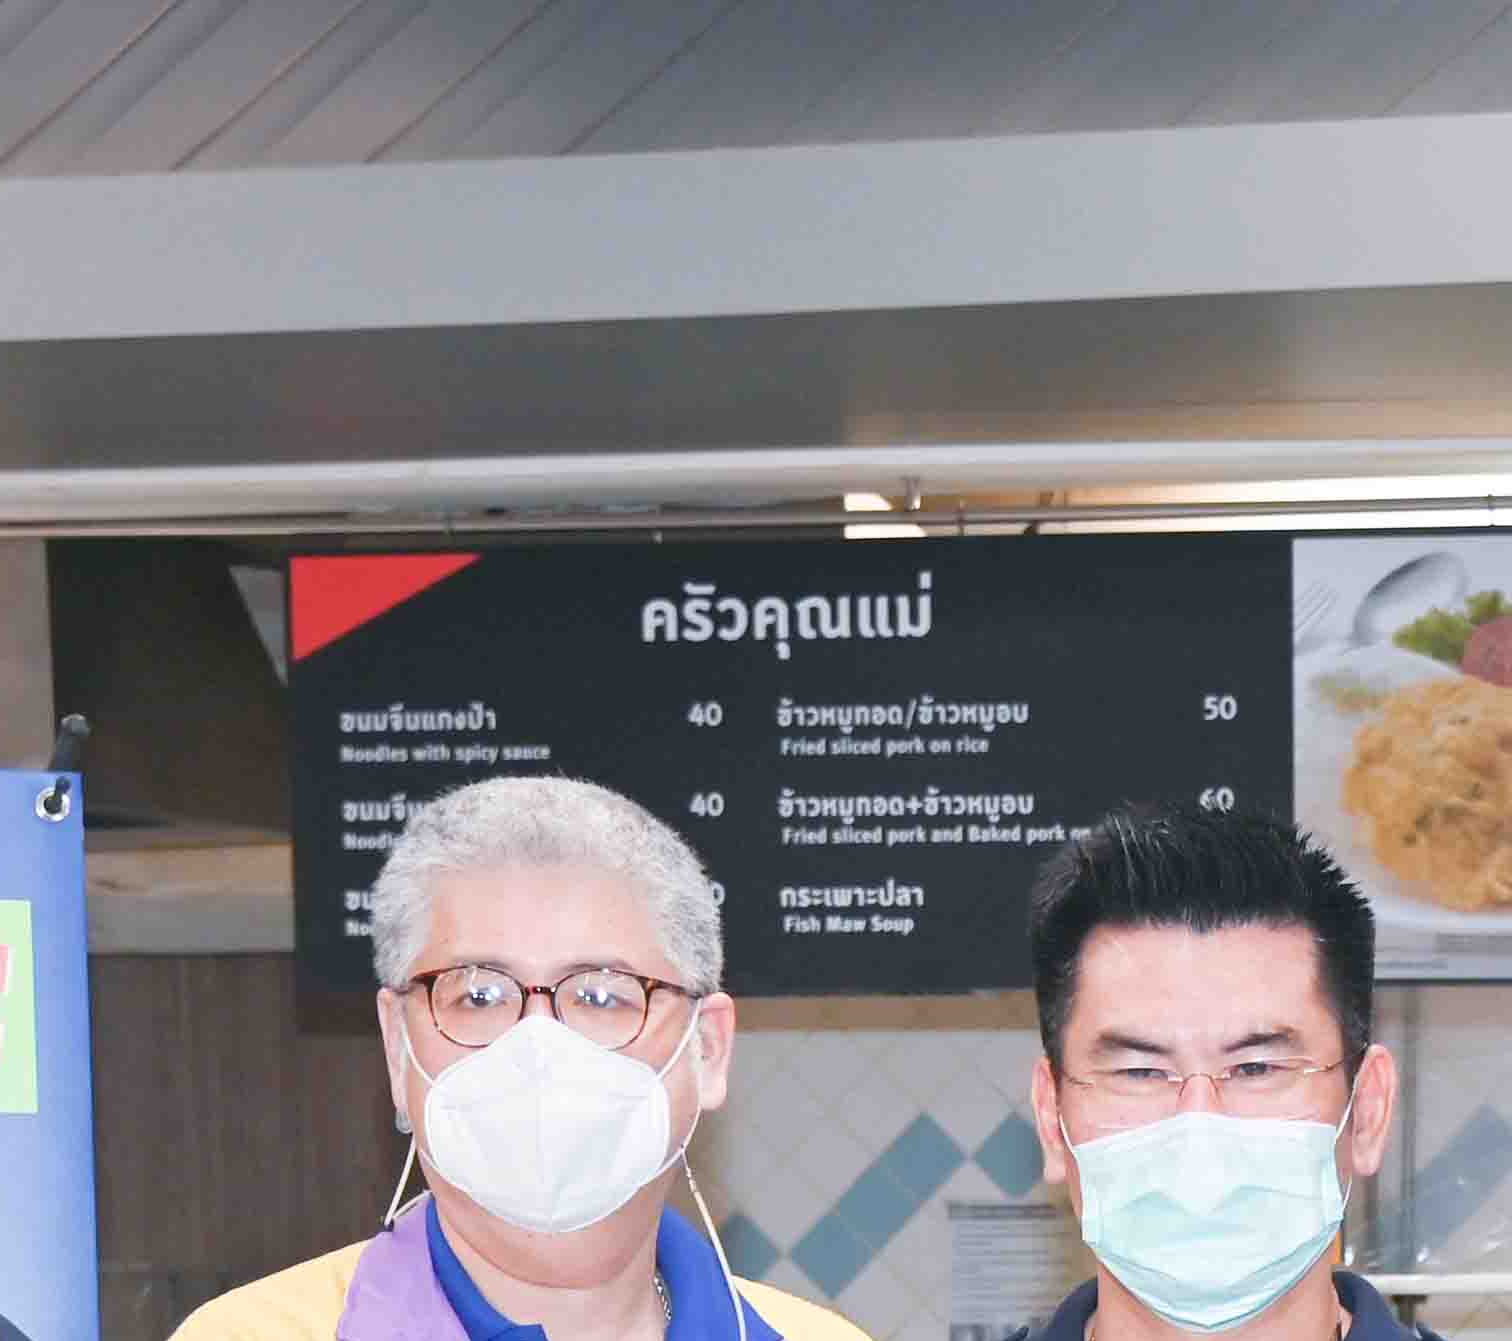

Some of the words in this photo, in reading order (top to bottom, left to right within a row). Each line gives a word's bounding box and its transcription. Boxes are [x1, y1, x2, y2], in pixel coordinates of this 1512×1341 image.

[641, 572, 933, 660] ครัวคุณแม่
[688, 701, 722, 727] 40
[1203, 696, 1237, 721] 50
[412, 744, 451, 762] with
[781, 738, 826, 756] Fried
[832, 738, 880, 755] sliced
[886, 737, 924, 758] pork
[929, 740, 951, 754] on
[956, 737, 988, 753] rice
[690, 792, 725, 818] 40
[782, 827, 827, 845] Fried
[832, 827, 882, 844] sliced
[887, 827, 926, 847] pork
[932, 827, 962, 843] and
[968, 826, 1020, 843] Baked
[1026, 826, 1064, 846] pork
[780, 878, 923, 908] กระเพาะปลา
[784, 916, 821, 934] Fish
[826, 917, 866, 932] Maw
[871, 916, 914, 936] Soup
